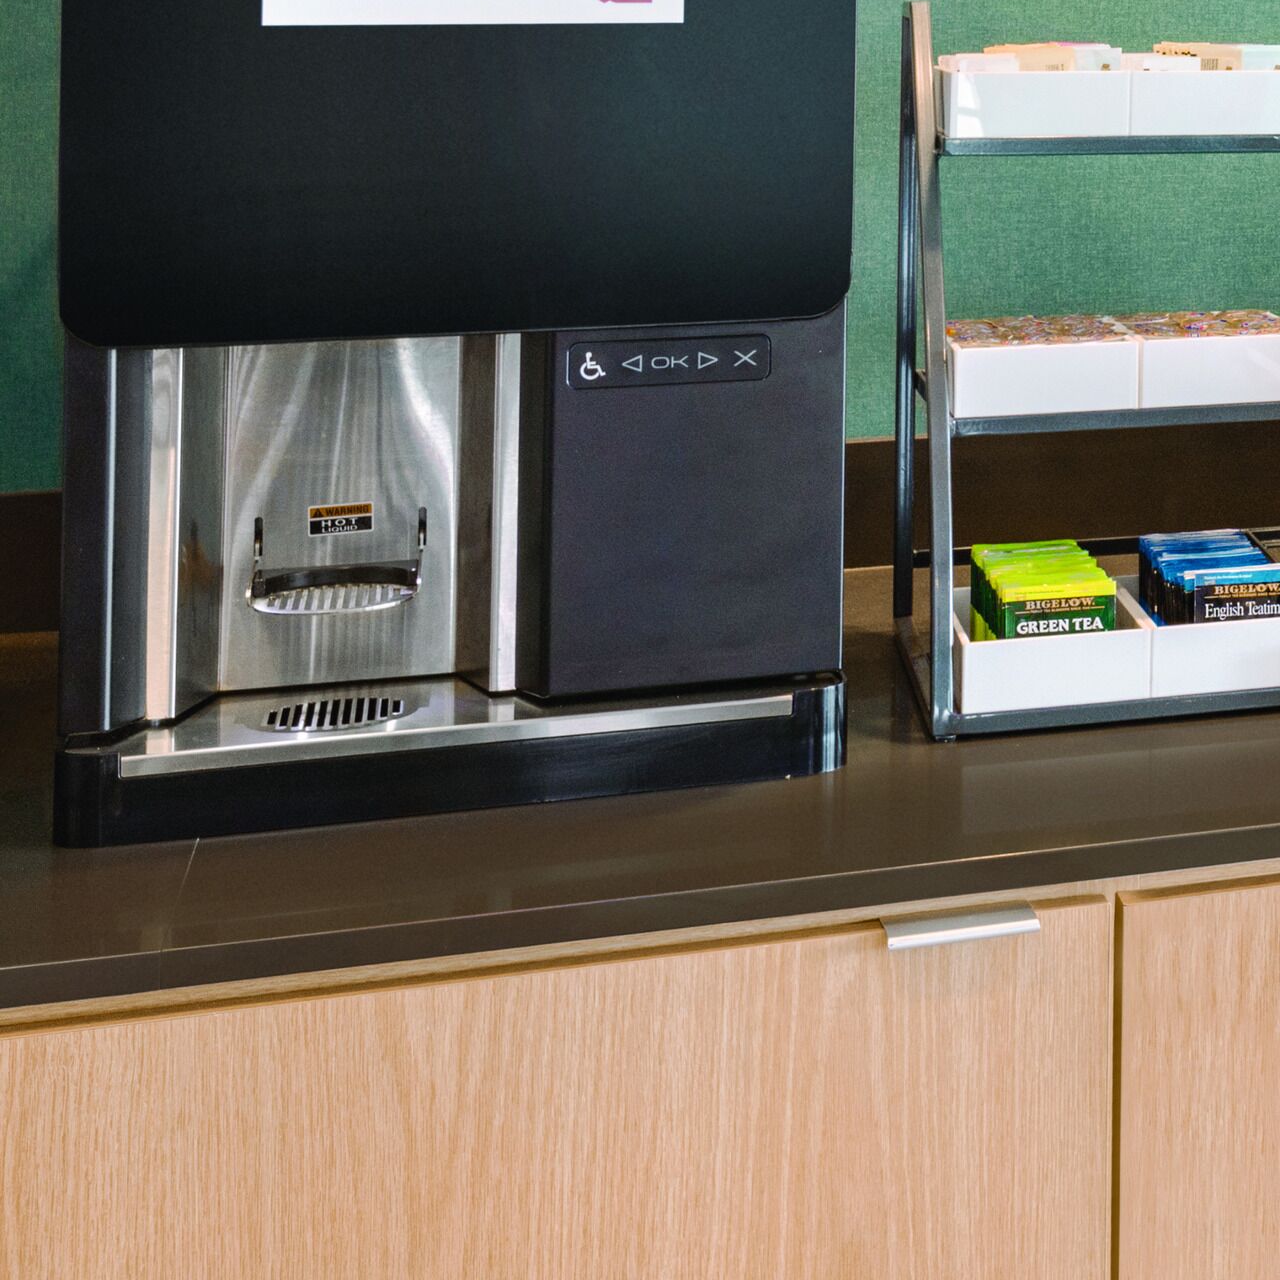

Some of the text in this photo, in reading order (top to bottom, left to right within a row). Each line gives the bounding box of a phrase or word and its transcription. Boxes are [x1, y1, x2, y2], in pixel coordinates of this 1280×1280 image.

[651, 355, 688, 369] OK
[325, 504, 369, 517] WARNING
[321, 517, 358, 528] HOT
[321, 525, 358, 533] LIQUID
[1205, 601, 1245, 620] English
[1016, 616, 1105, 635] GREEN TEA
